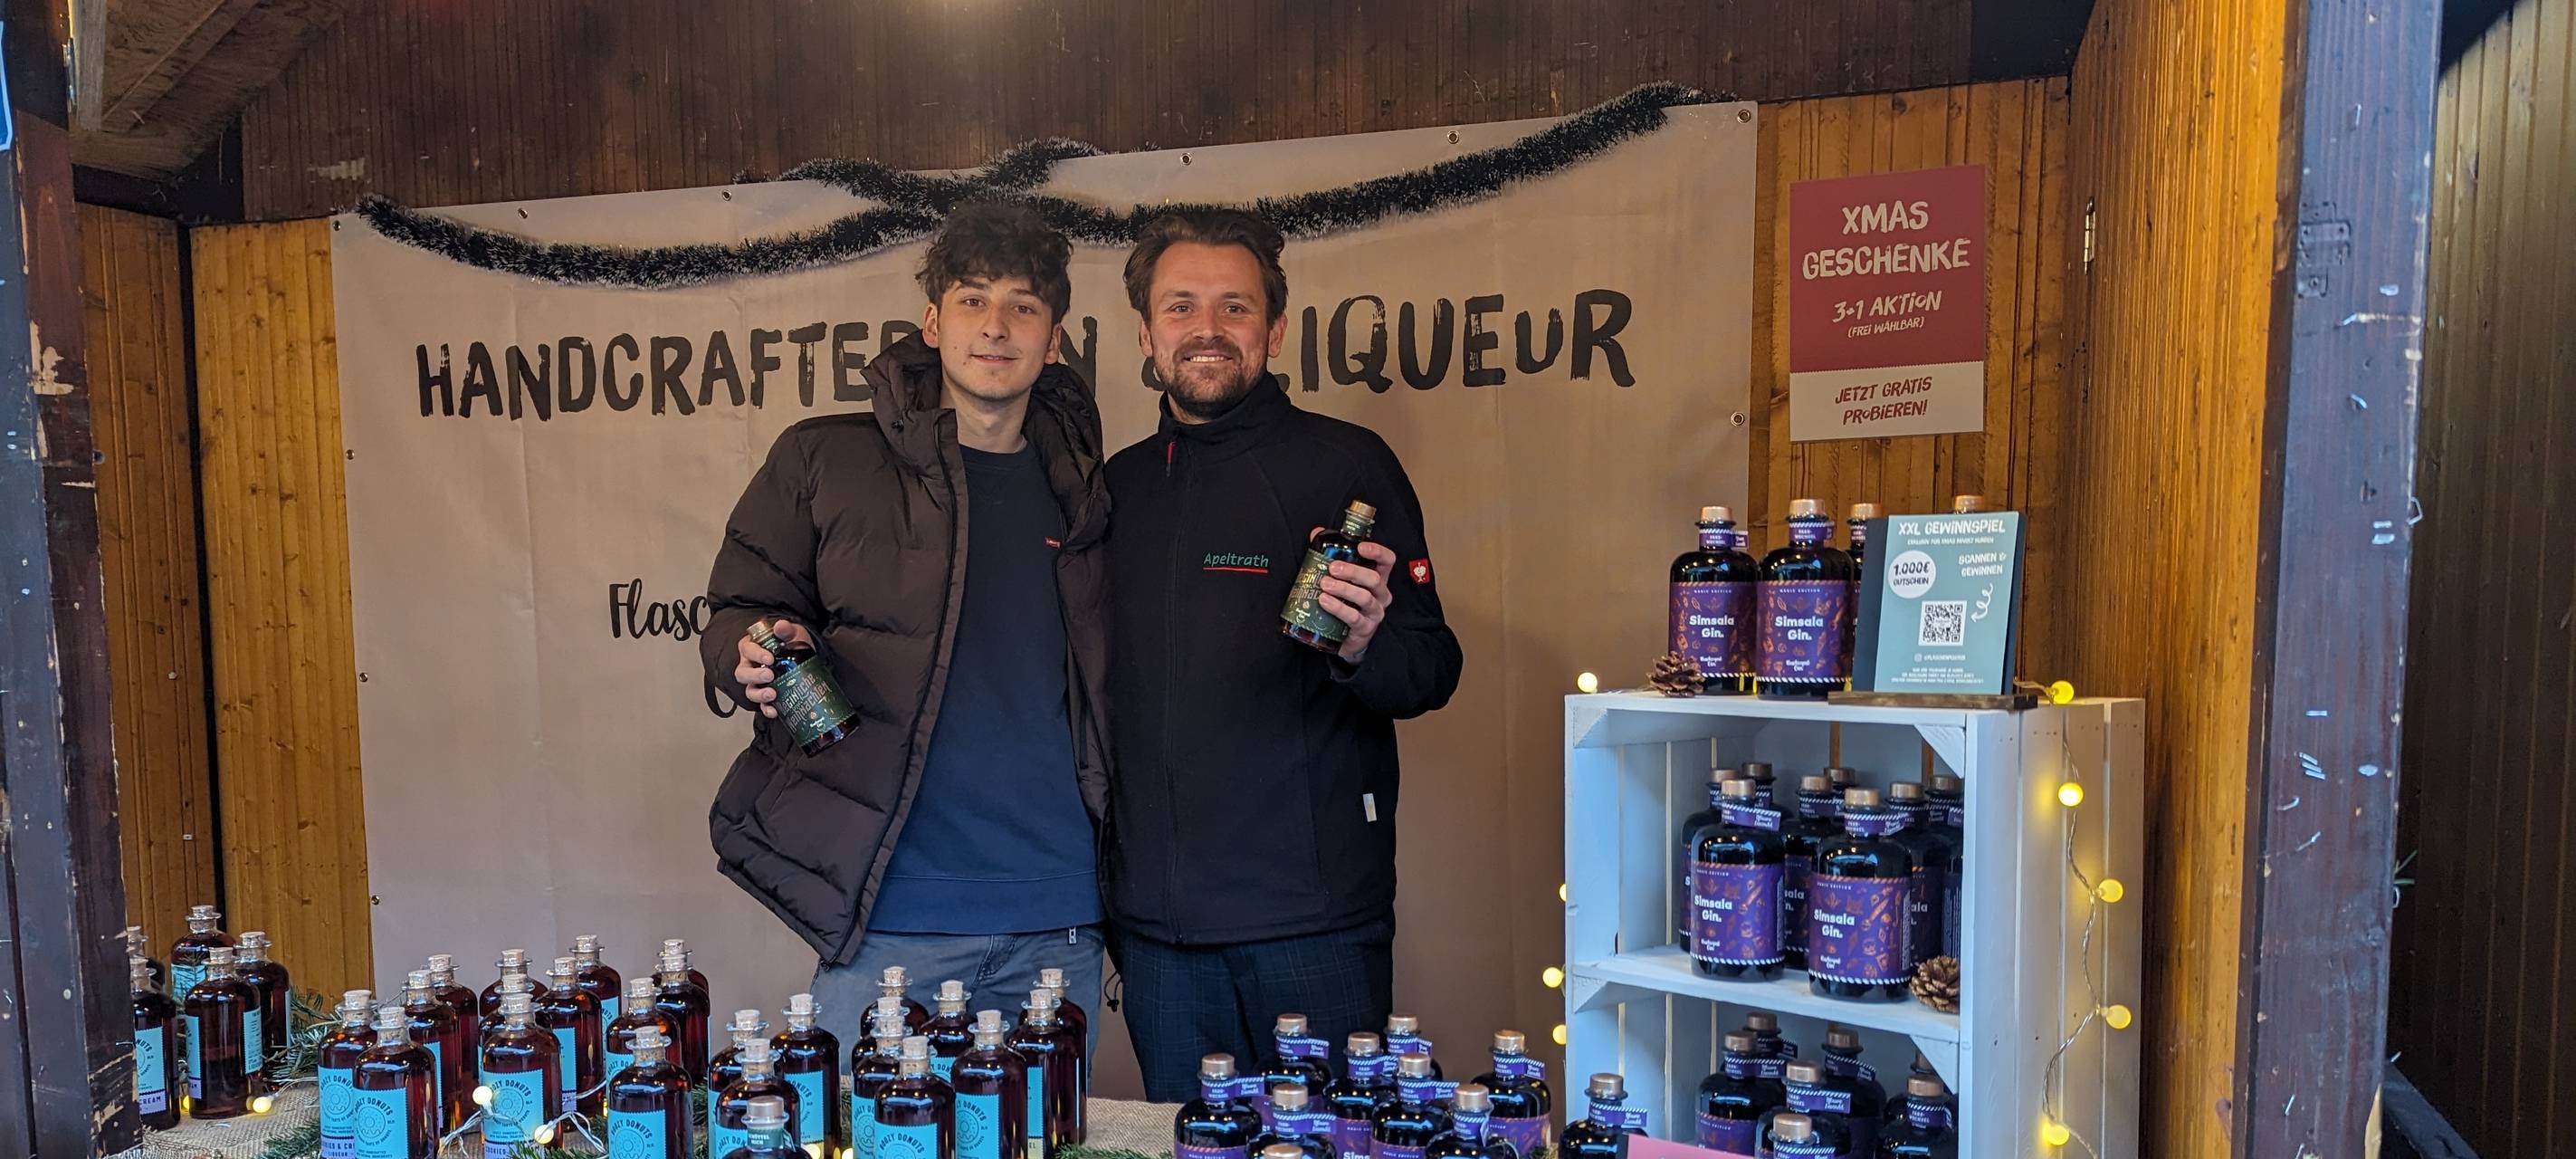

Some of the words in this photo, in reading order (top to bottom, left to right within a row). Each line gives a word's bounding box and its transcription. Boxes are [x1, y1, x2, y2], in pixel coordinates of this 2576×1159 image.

[1841, 200, 1929, 235] XMAS
[1802, 237, 1971, 280] GESCHENKE
[1869, 290, 1942, 317] AKTION
[1282, 289, 1636, 394] IQUEUR
[416, 321, 921, 421] HANDCRAFTE
[1835, 384, 1878, 404] JETZT
[1882, 376, 1932, 397] GRATIS
[1842, 398, 1927, 426] PROBIEREN!
[1898, 522, 1921, 536] XXL
[1924, 519, 2005, 535] GEWINNSPIEL
[1203, 552, 1269, 568] Apeltrath
[1959, 551, 1997, 565] SCANNEN
[1893, 561, 1931, 577] 1.000€
[1961, 564, 2003, 577] GEWINNEN
[1893, 577, 1929, 587] GUTSCHEIN
[609, 578, 712, 642] Flasc
[1689, 615, 1734, 626] Simsala
[1775, 616, 1824, 627] Simsala
[1701, 627, 1724, 638] Gin.
[1788, 629, 1812, 640] Gin.
[1693, 895, 1732, 910] Simsala
[1784, 889, 1805, 900] sala
[1702, 910, 1722, 923] Gin.
[1813, 909, 1855, 926] Simsala
[1821, 924, 1844, 938] Gin.
[136, 1038, 153, 1052] NUTS
[333, 1075, 353, 1087] DONU
[505, 1078, 531, 1097] DONUTS
[138, 1095, 162, 1106] CREAM
[367, 1097, 394, 1116] DONUTS
[963, 1100, 987, 1122] DONUTS
[625, 1118, 652, 1139] DONUTS
[731, 1135, 747, 1145] DON
[897, 1133, 925, 1154] DONUTS
